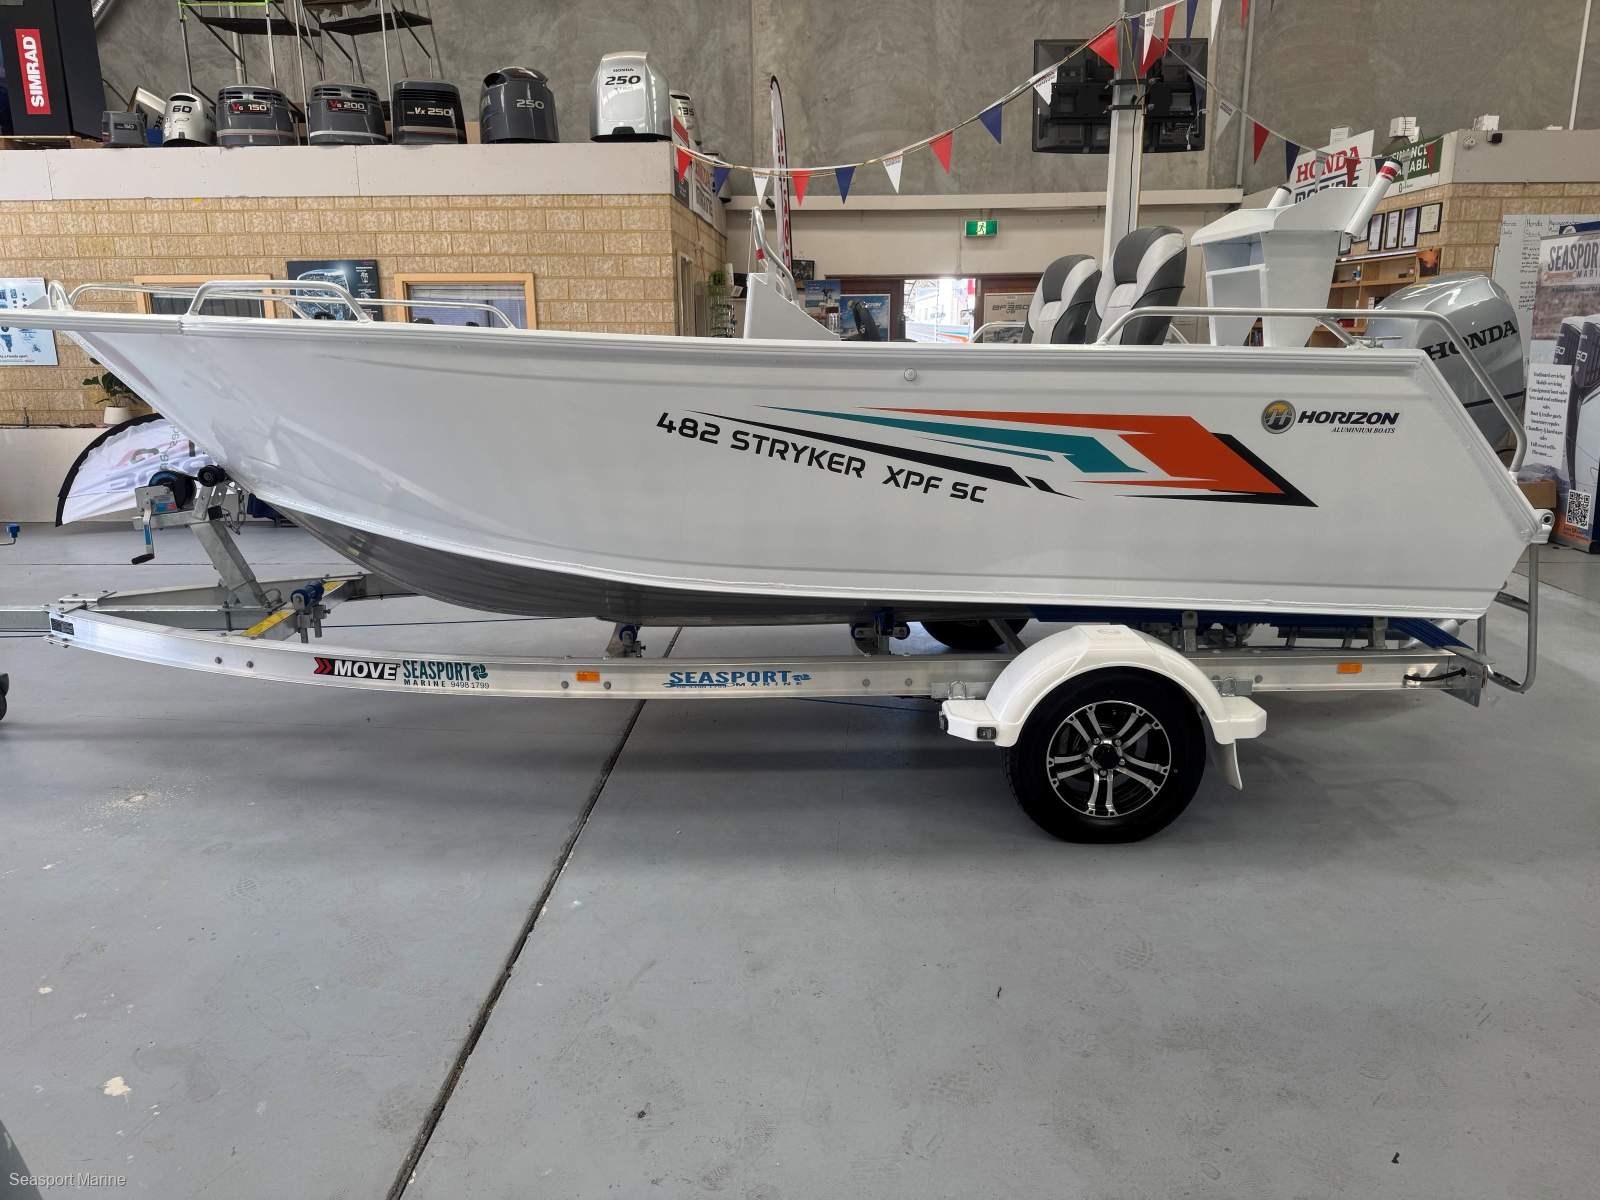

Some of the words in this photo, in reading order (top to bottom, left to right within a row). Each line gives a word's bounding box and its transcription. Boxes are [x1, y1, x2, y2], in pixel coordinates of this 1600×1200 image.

[22, 36, 45, 108] SIMRAD
[604, 75, 641, 86] 250
[172, 105, 193, 114] 60
[247, 103, 267, 111] 150
[343, 101, 365, 110] 200
[516, 98, 545, 110] 250
[427, 107, 452, 116] 250
[1547, 241, 1600, 271] SEASPOR
[1421, 319, 1518, 362] HONDA
[1297, 410, 1400, 425] HORIZON
[1331, 426, 1373, 434] ALUMINIUM
[1373, 426, 1396, 434] BOATS
[656, 412, 721, 445] 482
[730, 430, 866, 479] STRYKER
[882, 465, 944, 494] XPF
[950, 481, 988, 504] SC
[333, 659, 397, 680] MOVE
[402, 659, 473, 682] SEASPORT
[403, 678, 446, 688] MARINE
[669, 670, 793, 684] SEASPORT
